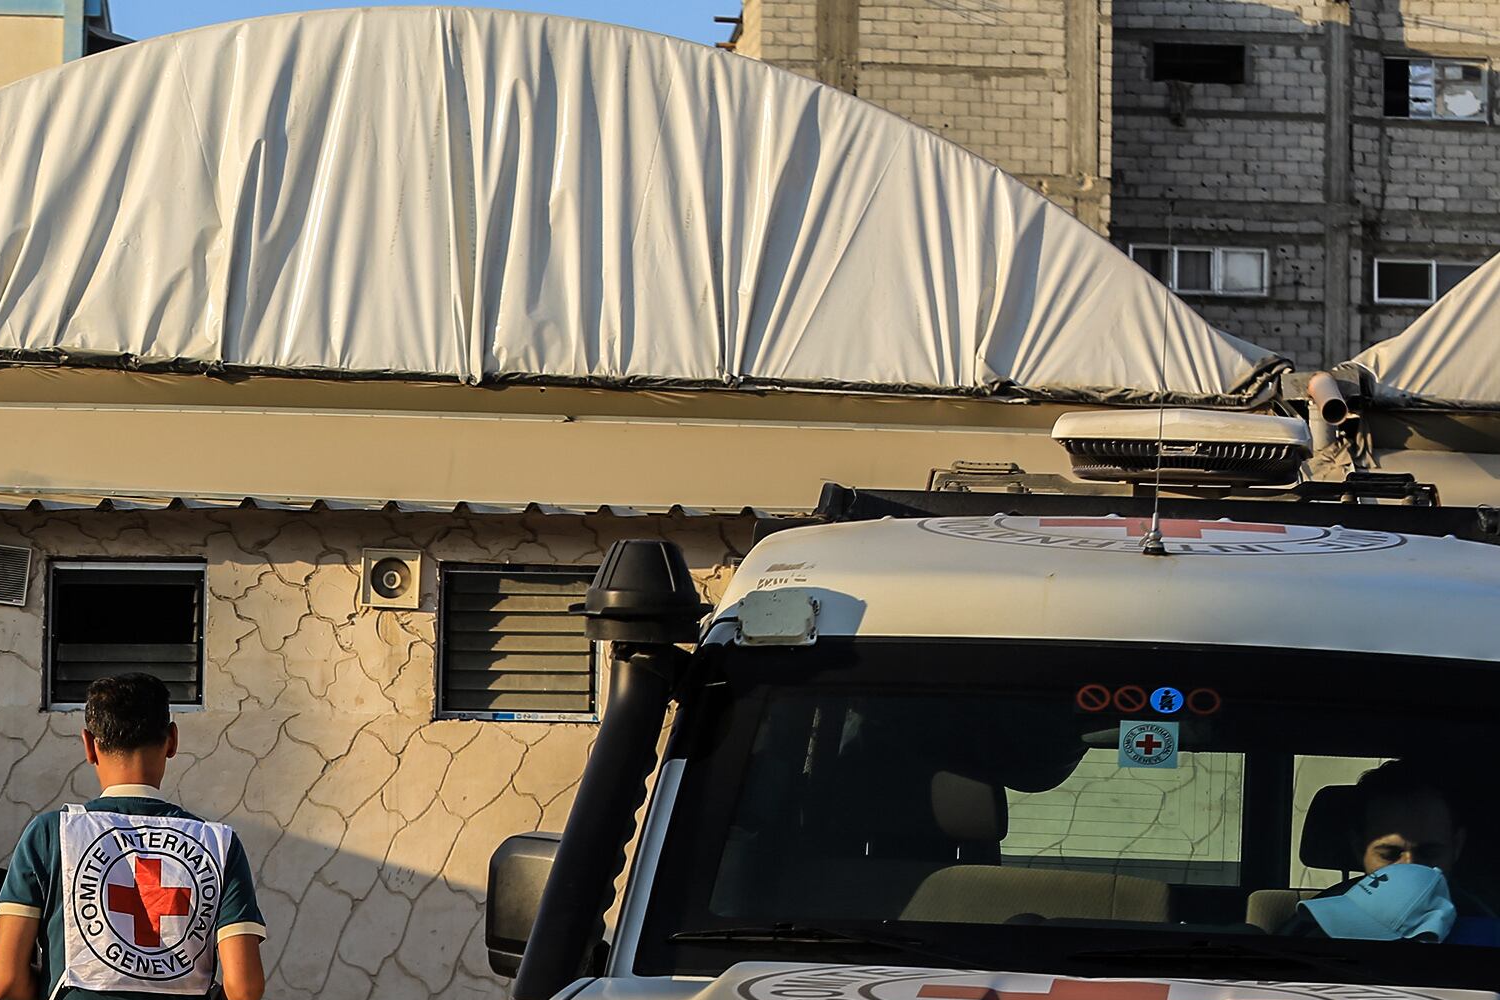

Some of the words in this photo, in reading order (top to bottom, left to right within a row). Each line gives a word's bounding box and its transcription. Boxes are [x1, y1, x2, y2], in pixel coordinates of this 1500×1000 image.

[80, 847, 111, 937] COMITE
[113, 832, 217, 942] INTERNATIONAL
[105, 942, 192, 975] GENEVE
